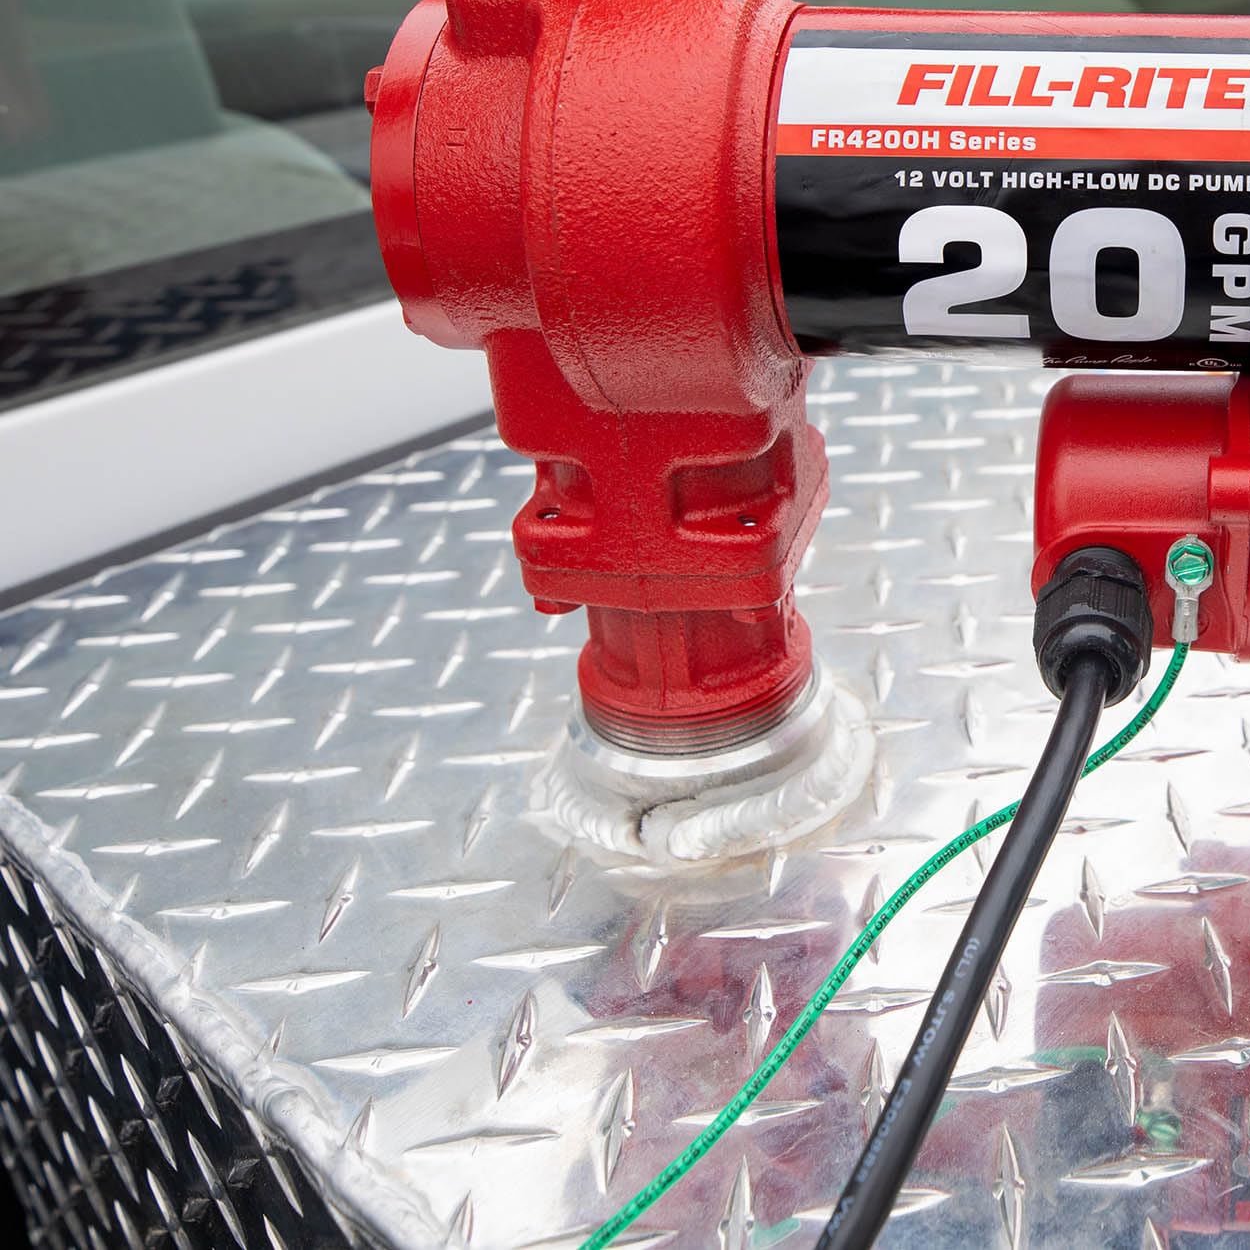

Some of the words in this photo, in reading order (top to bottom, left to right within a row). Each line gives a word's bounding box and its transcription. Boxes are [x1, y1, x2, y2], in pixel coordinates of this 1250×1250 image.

[811, 129, 940, 151] FR4200H
[949, 131, 1037, 151] Series
[894, 170, 923, 189] 12
[932, 170, 994, 190] VOLT
[1002, 171, 1140, 191] HIGH-FLOW
[1148, 173, 1181, 192] DC
[898, 204, 1186, 343] 20
[1119, 731, 1135, 746] OR
[827, 958, 854, 992] TYPE
[853, 930, 875, 959] MTW
[874, 913, 891, 932] OR
[889, 881, 917, 914] THWN
[917, 868, 931, 885] OR
[985, 813, 1008, 831] AND
